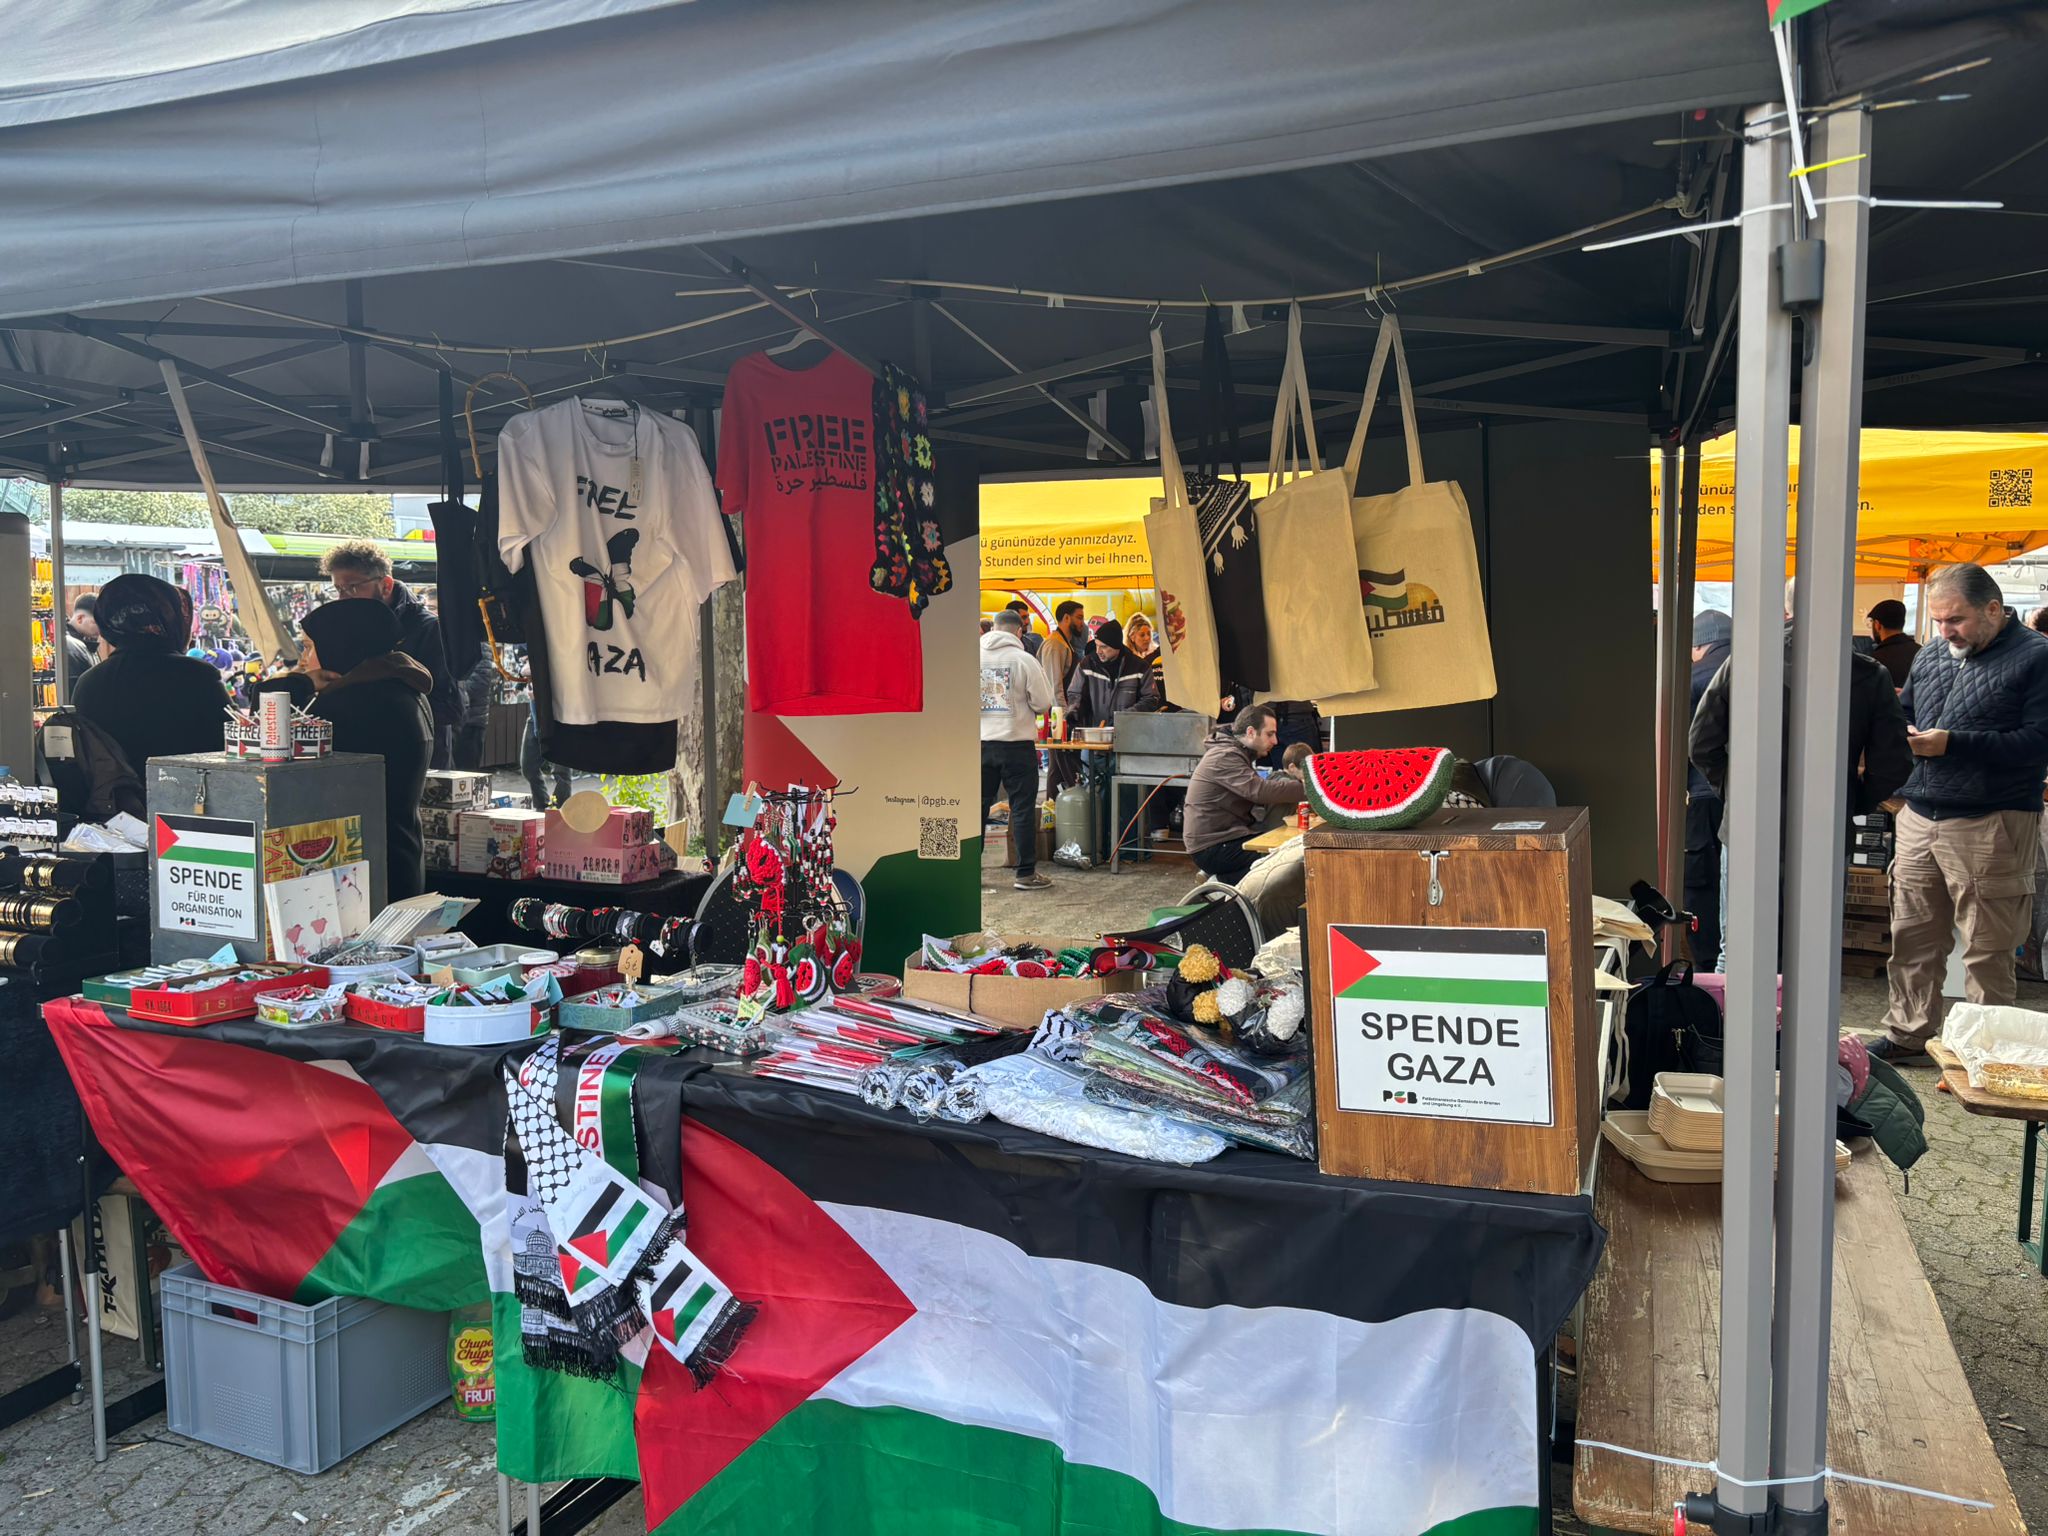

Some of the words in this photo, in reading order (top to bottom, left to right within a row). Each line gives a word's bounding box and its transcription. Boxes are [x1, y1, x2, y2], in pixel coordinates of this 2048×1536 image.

[764, 414, 866, 456] FREE
[771, 449, 866, 474] PALESTINE
[990, 535, 1056, 551] gününüzde
[1058, 532, 1137, 549] yanınızdayız.
[985, 555, 1034, 568] Stunden
[1036, 554, 1062, 567] sind
[1064, 554, 1084, 566] wir
[1087, 553, 1106, 565] bei
[1108, 552, 1148, 565] Ihnen.
[294, 725, 319, 740] FREE
[921, 796, 960, 808] @pgb.ev
[169, 866, 243, 892] SPENDE
[187, 890, 208, 904] FÜR
[208, 893, 225, 906] DIE
[171, 901, 242, 919] ORGANISATION
[1360, 1012, 1521, 1048] SPENDE
[1387, 1052, 1497, 1087] GAZA
[576, 1053, 616, 1159] STINE
